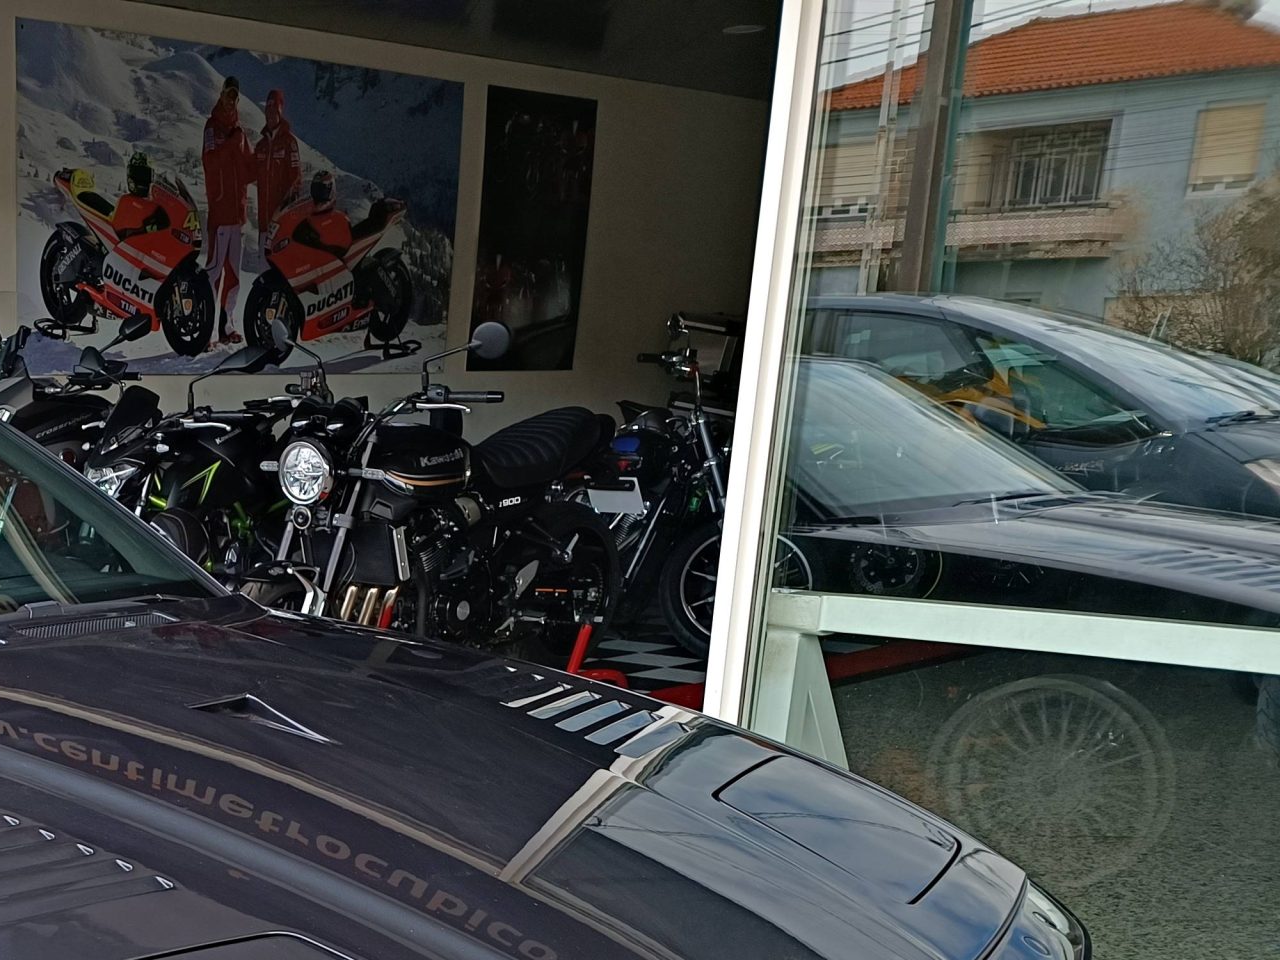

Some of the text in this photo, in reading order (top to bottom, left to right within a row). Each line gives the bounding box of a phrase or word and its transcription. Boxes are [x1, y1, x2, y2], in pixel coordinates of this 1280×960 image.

[103, 263, 155, 304] DUCATI
[120, 300, 138, 316] TIM
[307, 280, 354, 317] DUCATI
[332, 307, 348, 323] TIM
